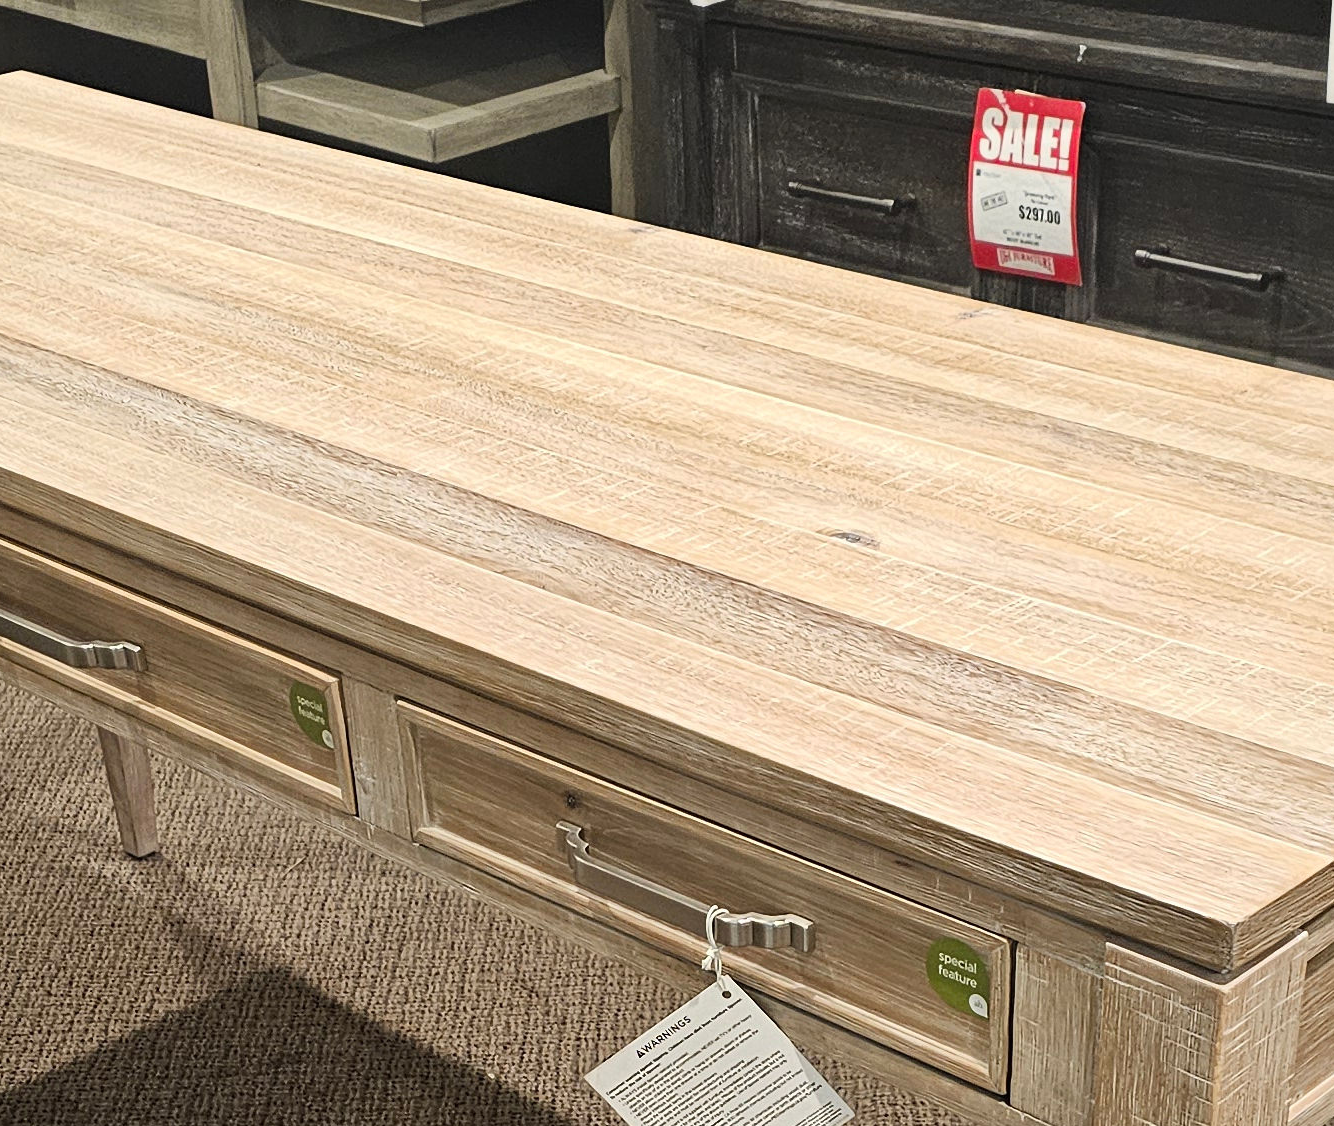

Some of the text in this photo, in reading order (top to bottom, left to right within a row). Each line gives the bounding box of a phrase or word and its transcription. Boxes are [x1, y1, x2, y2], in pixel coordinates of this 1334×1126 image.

[979, 107, 1074, 172] SALE!
[1018, 204, 1061, 225] $297.00
[297, 695, 323, 713] special
[938, 952, 977, 975] special
[938, 964, 978, 989] feature
[641, 1015, 692, 1054] WARNINGS
